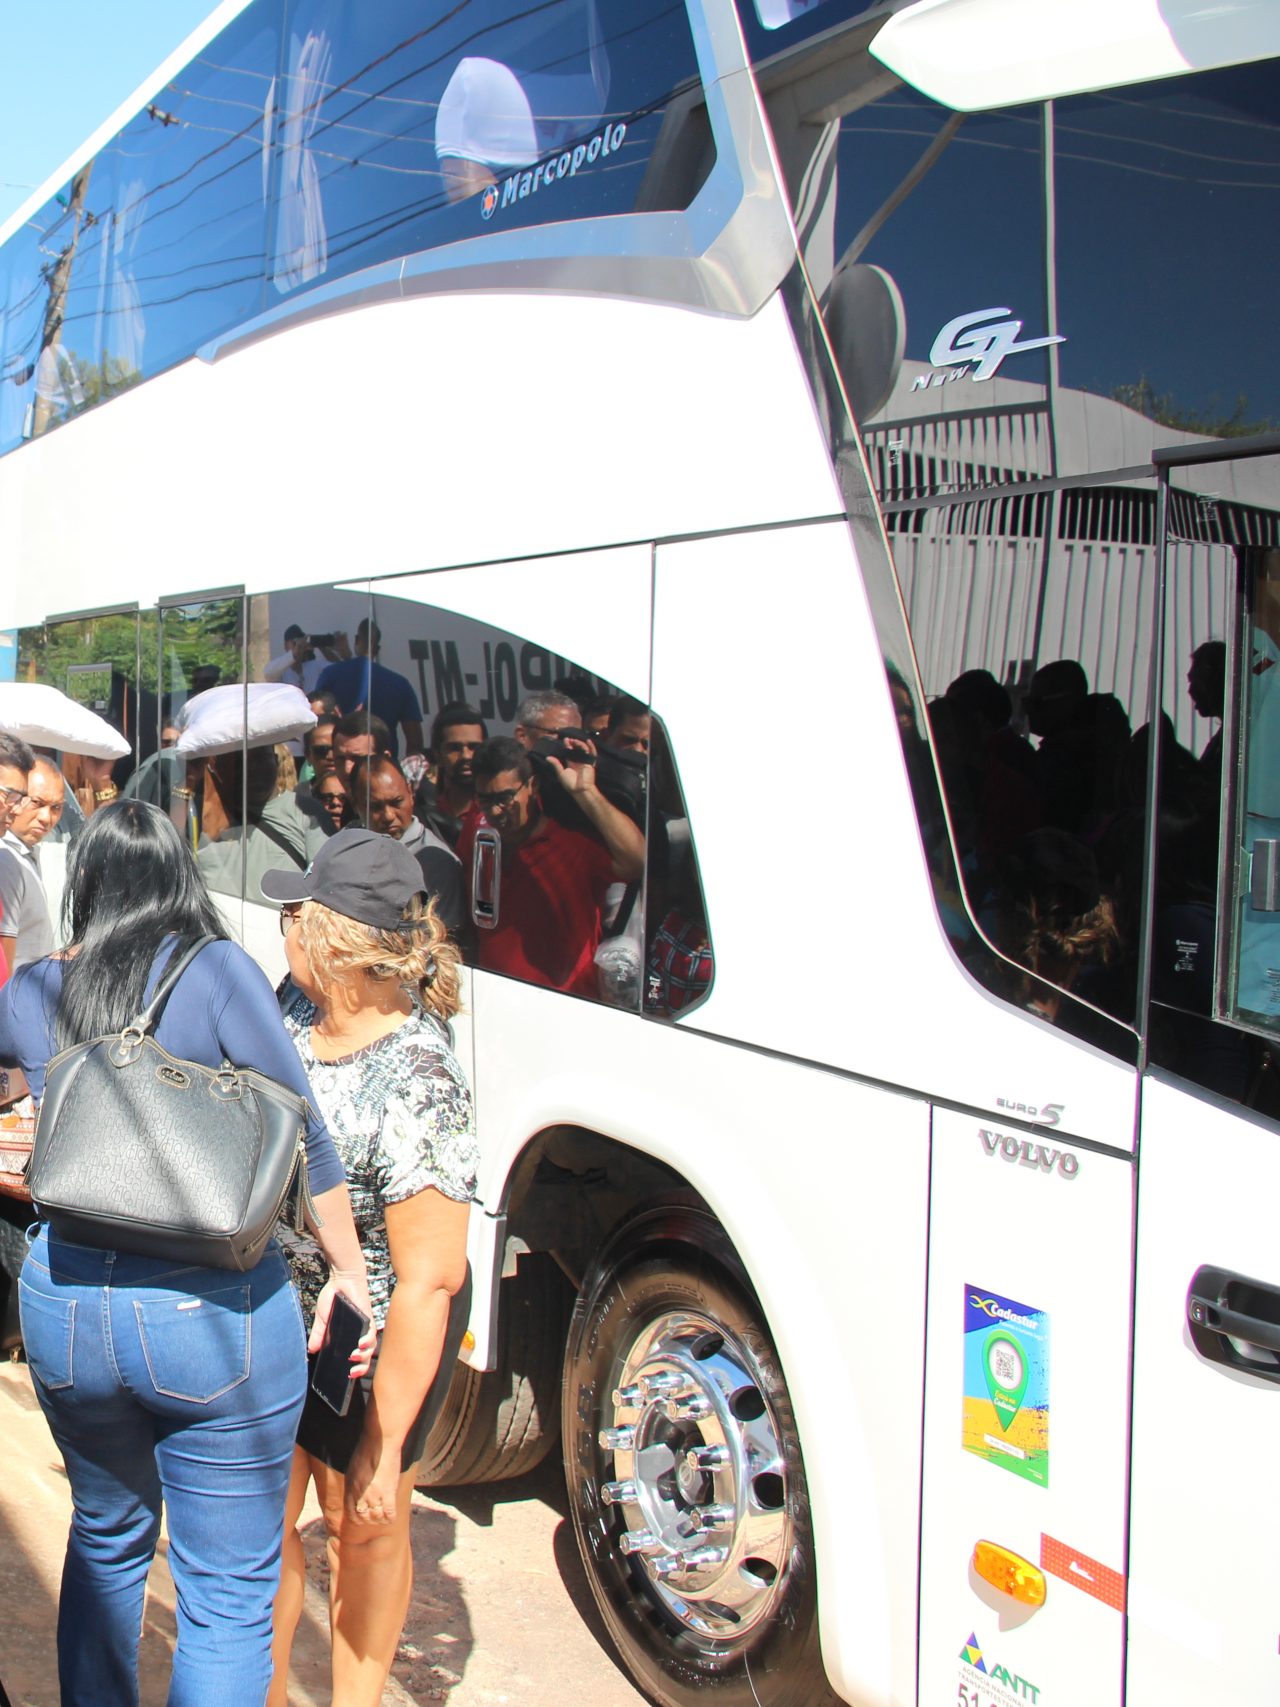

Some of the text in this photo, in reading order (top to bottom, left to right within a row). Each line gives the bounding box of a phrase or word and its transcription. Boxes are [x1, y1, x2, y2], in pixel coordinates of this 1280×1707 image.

[501, 123, 627, 208] Marcopolo
[996, 1097, 1065, 1126] EURO 5
[977, 1129, 1079, 1178] VOLVO
[989, 1663, 1041, 1705] ANTT
